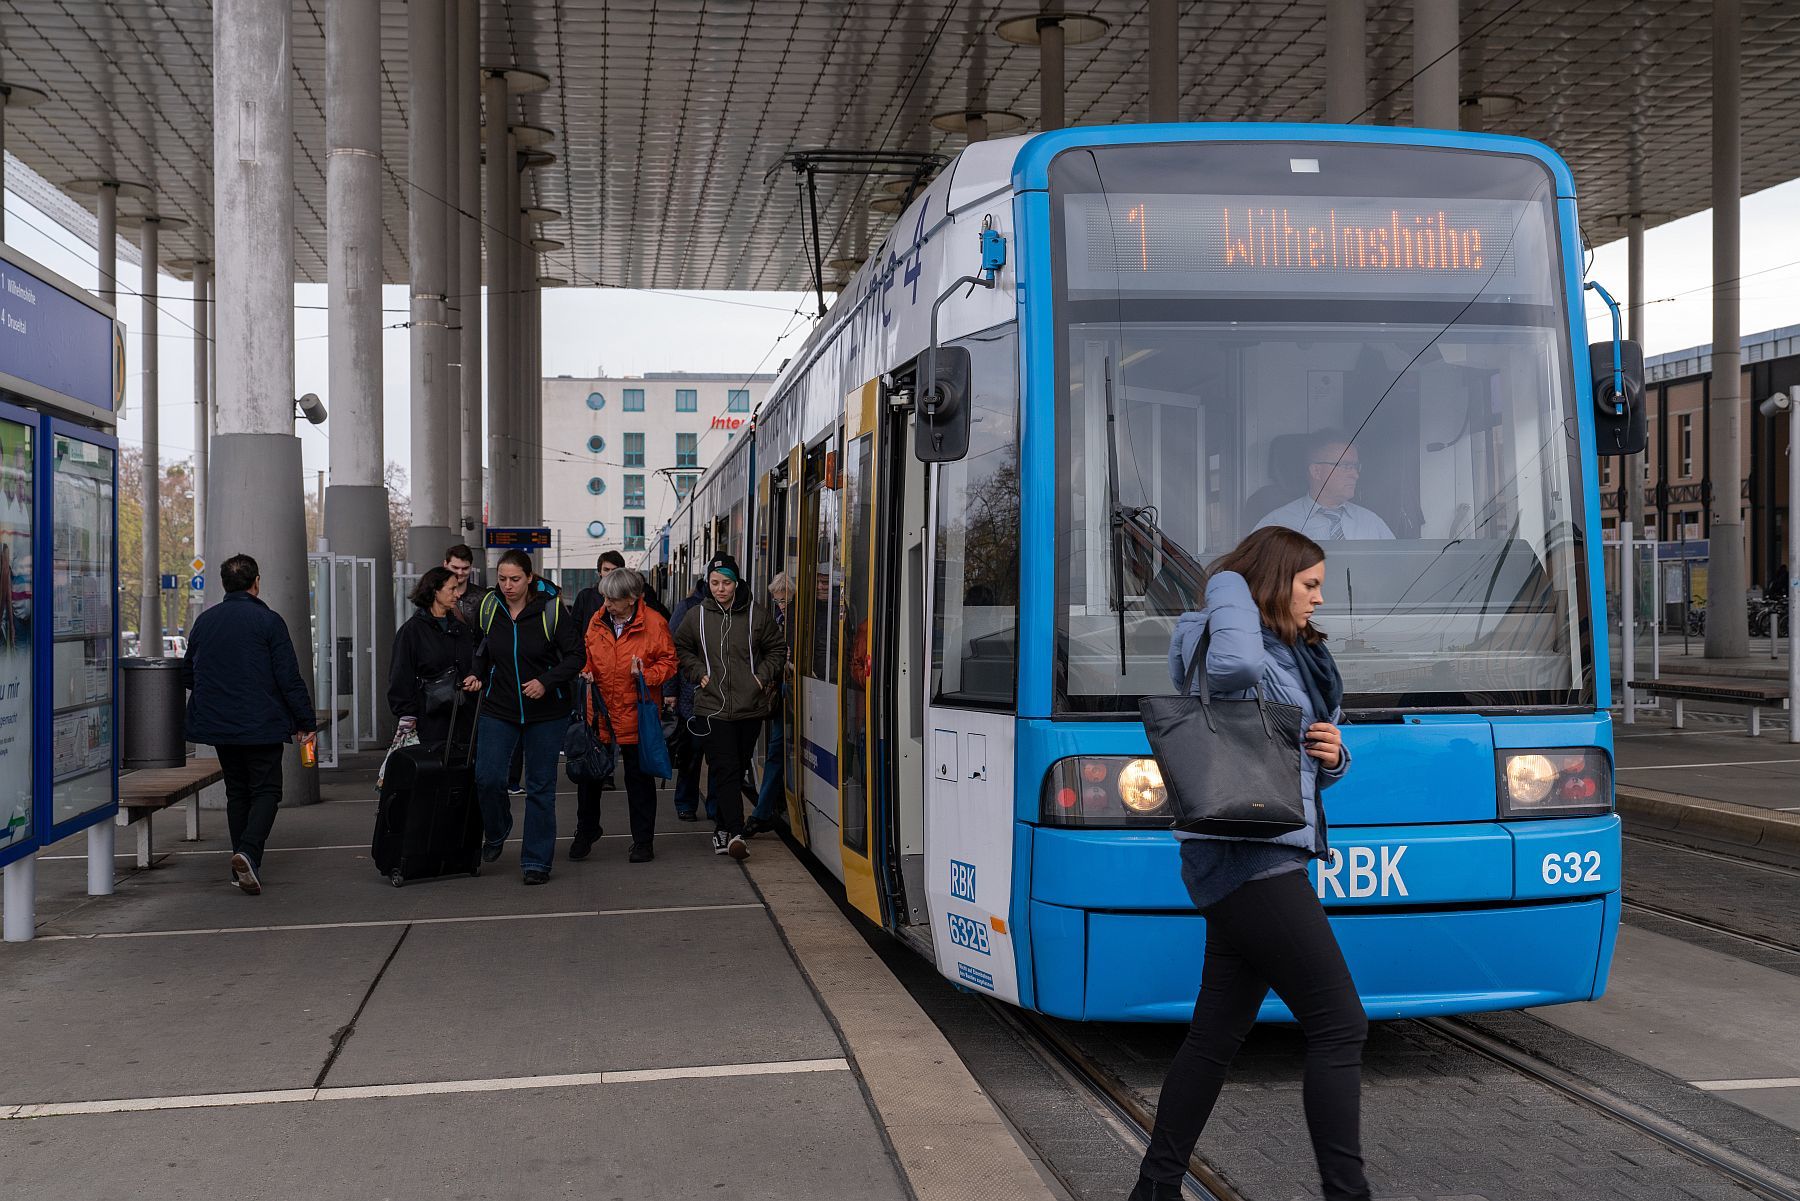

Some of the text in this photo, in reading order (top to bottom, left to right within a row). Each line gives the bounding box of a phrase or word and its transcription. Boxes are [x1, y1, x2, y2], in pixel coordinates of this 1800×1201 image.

[903, 194, 931, 306] 4
[1127, 203, 1483, 272] 1 Wilhelmshöhe
[7, 278, 37, 305] Wilhelmshöhe
[1, 307, 27, 335] 4 Druseltal
[7, 676, 20, 700] mir
[950, 861, 976, 901] RBK
[1316, 845, 1409, 899] RBK
[1541, 850, 1601, 885] 632
[948, 914, 991, 954] 632B
